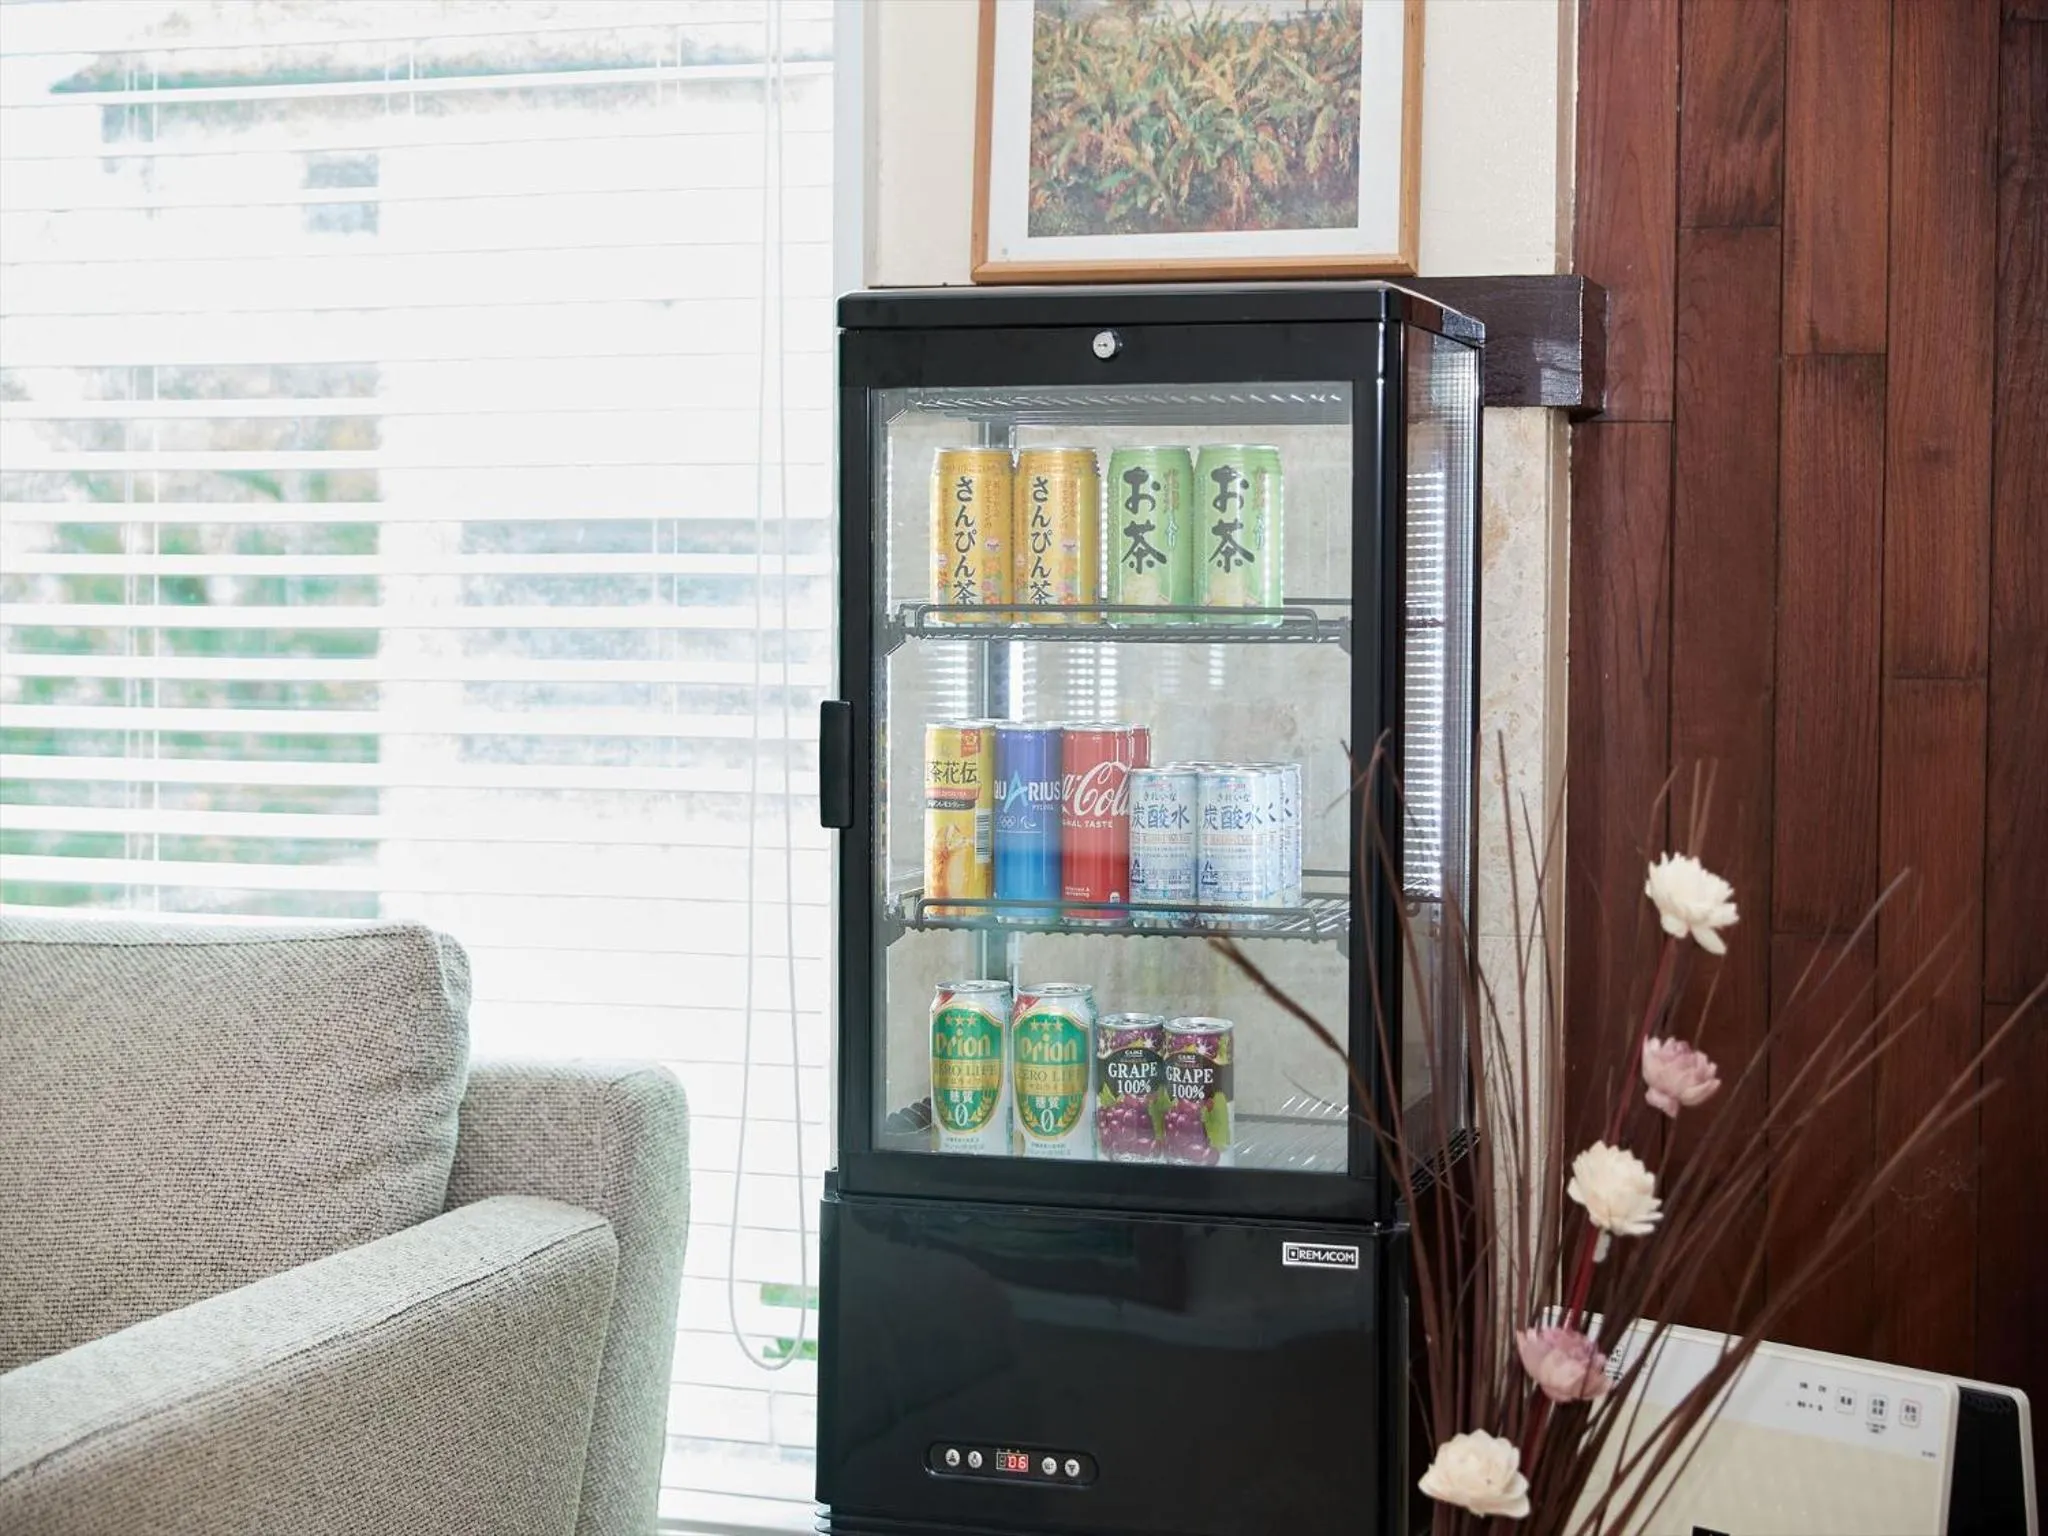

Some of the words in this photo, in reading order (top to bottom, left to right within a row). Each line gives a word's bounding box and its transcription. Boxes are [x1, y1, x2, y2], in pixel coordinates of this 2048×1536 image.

[1121, 466, 1168, 575] お茶
[1209, 464, 1256, 573] お茶
[953, 475, 978, 605] さんぴん茶
[1029, 475, 1054, 605] さんぴん茶
[1132, 802, 1191, 830] 炭酸水
[1203, 803, 1263, 831] 炭酸水
[1108, 1061, 1158, 1079] GRAPE
[1165, 1065, 1214, 1084] GRAPE
[1117, 1079, 1152, 1094] 100%
[1172, 1083, 1205, 1100] 100%
[1299, 1250, 1355, 1262] REMACOM
[1006, 1455, 1027, 1470] 06
